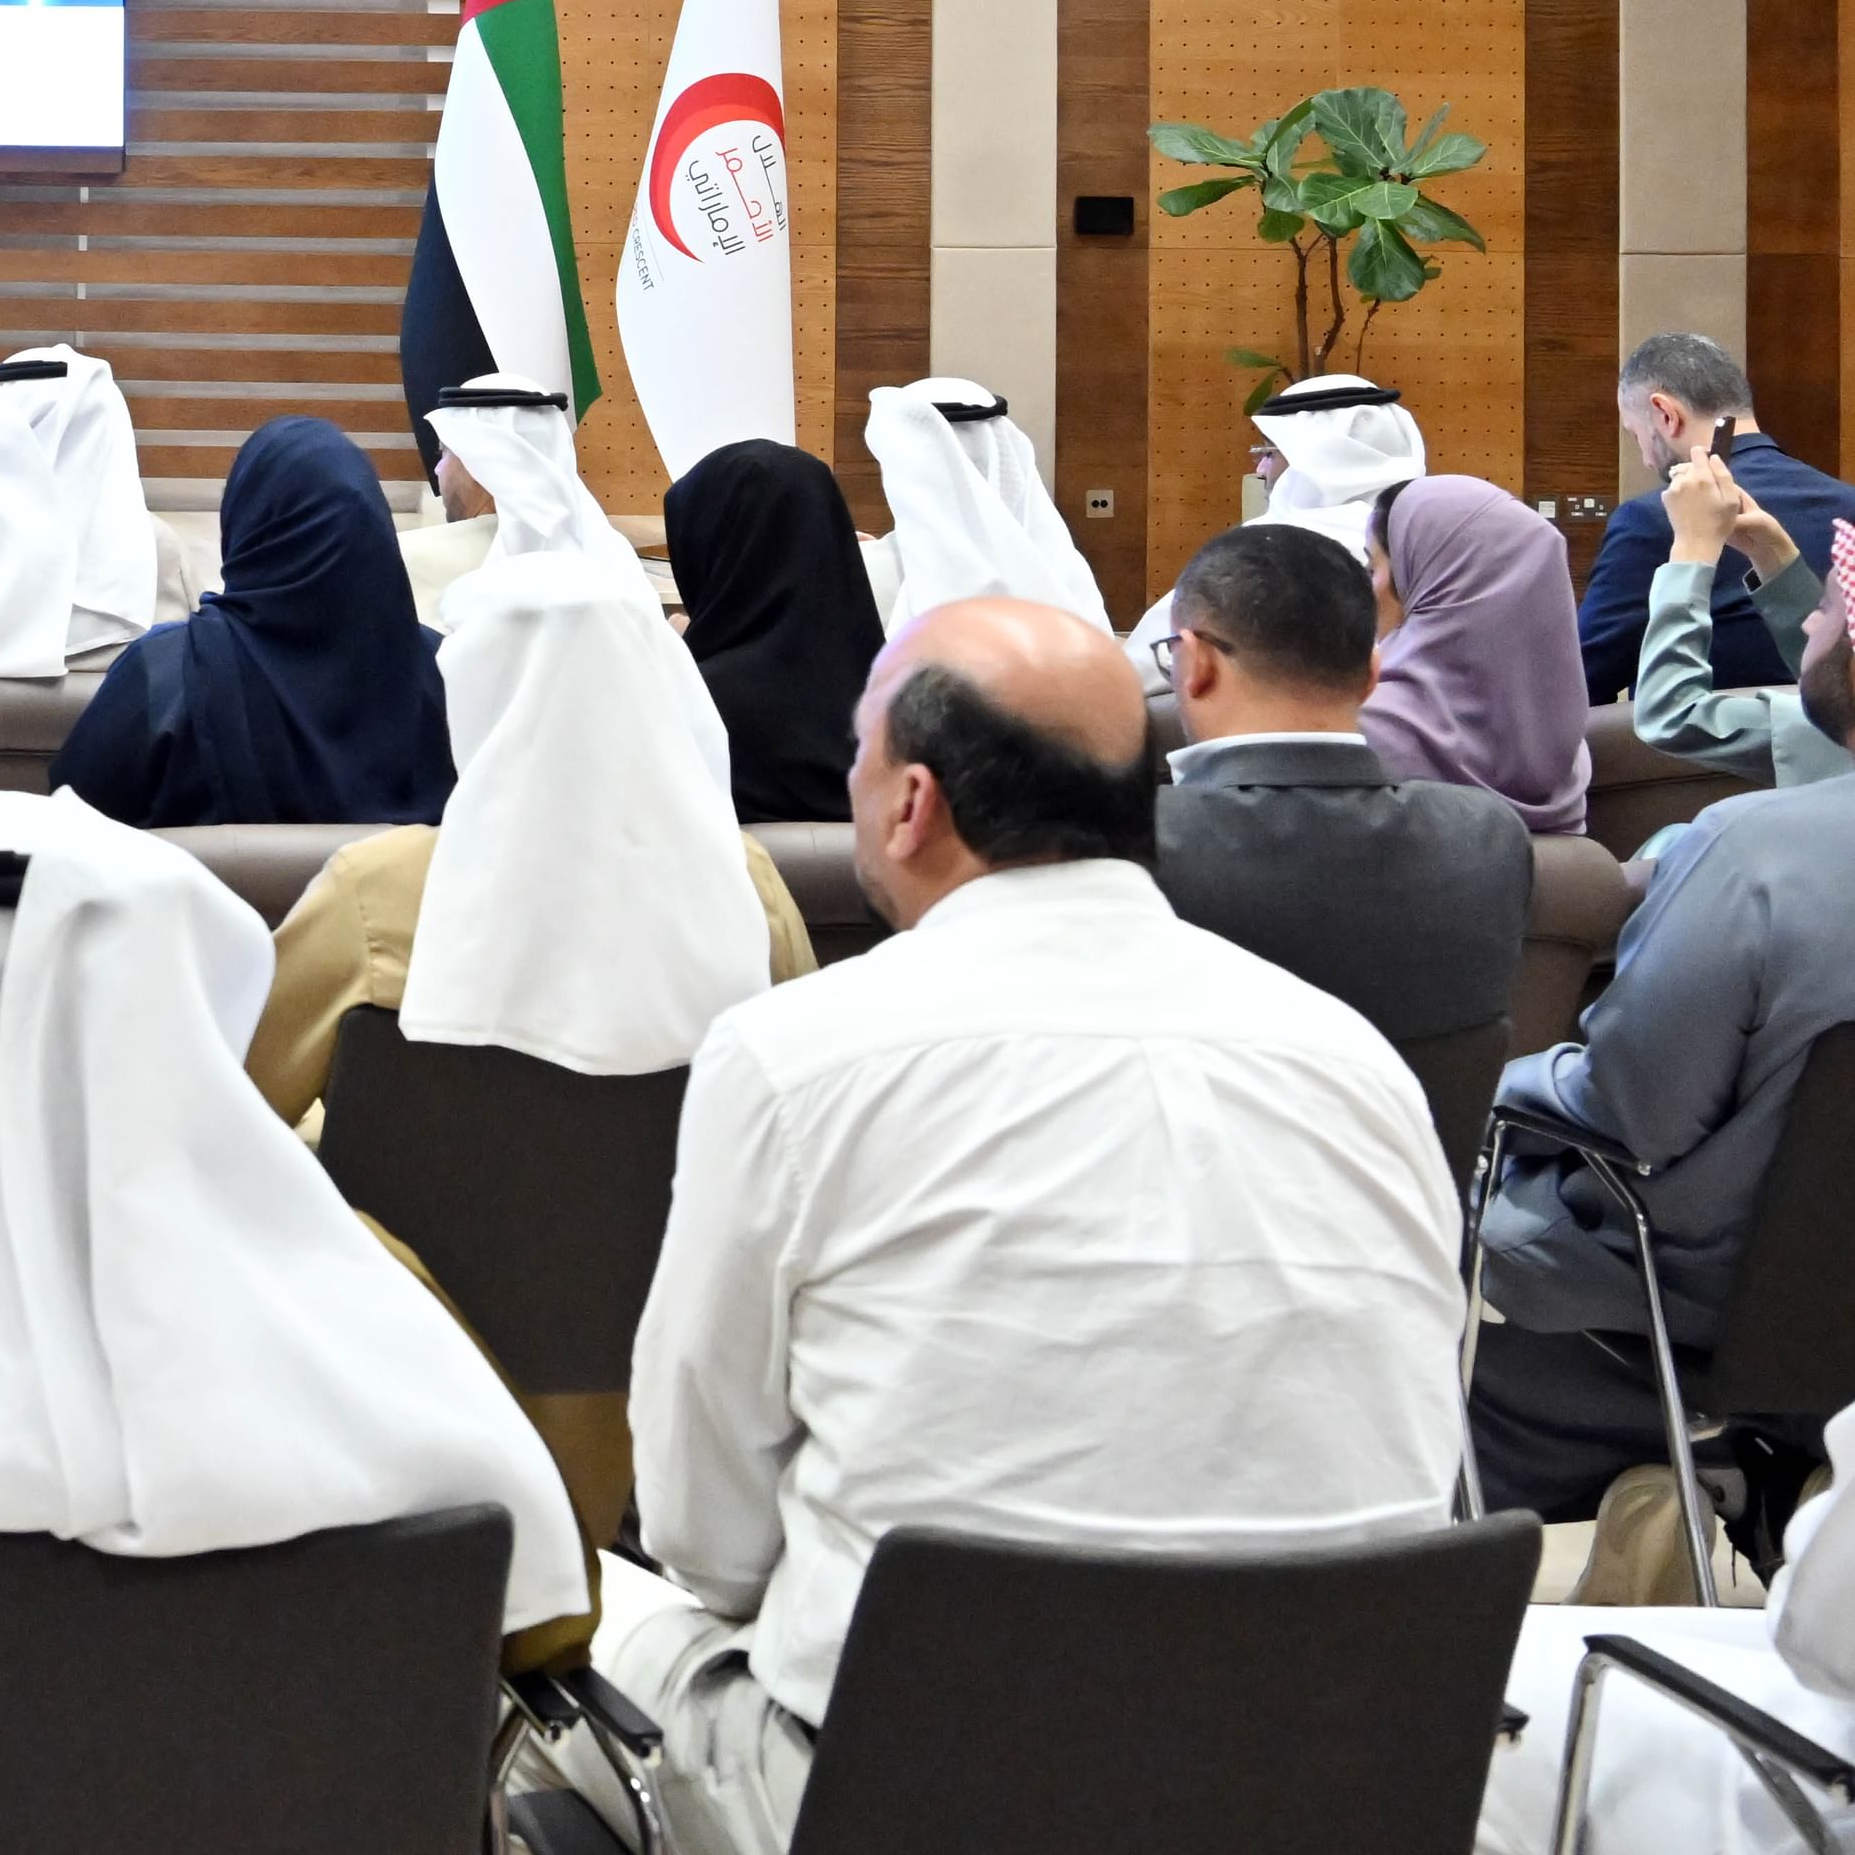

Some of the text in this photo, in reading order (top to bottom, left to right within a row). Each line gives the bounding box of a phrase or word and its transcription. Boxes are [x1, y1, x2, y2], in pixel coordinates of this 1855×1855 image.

[685, 159, 746, 256] الإماراتي
[715, 147, 774, 243] الأحمر
[752, 135, 787, 231] الهلال
[631, 228, 655, 291] CRESCENT
